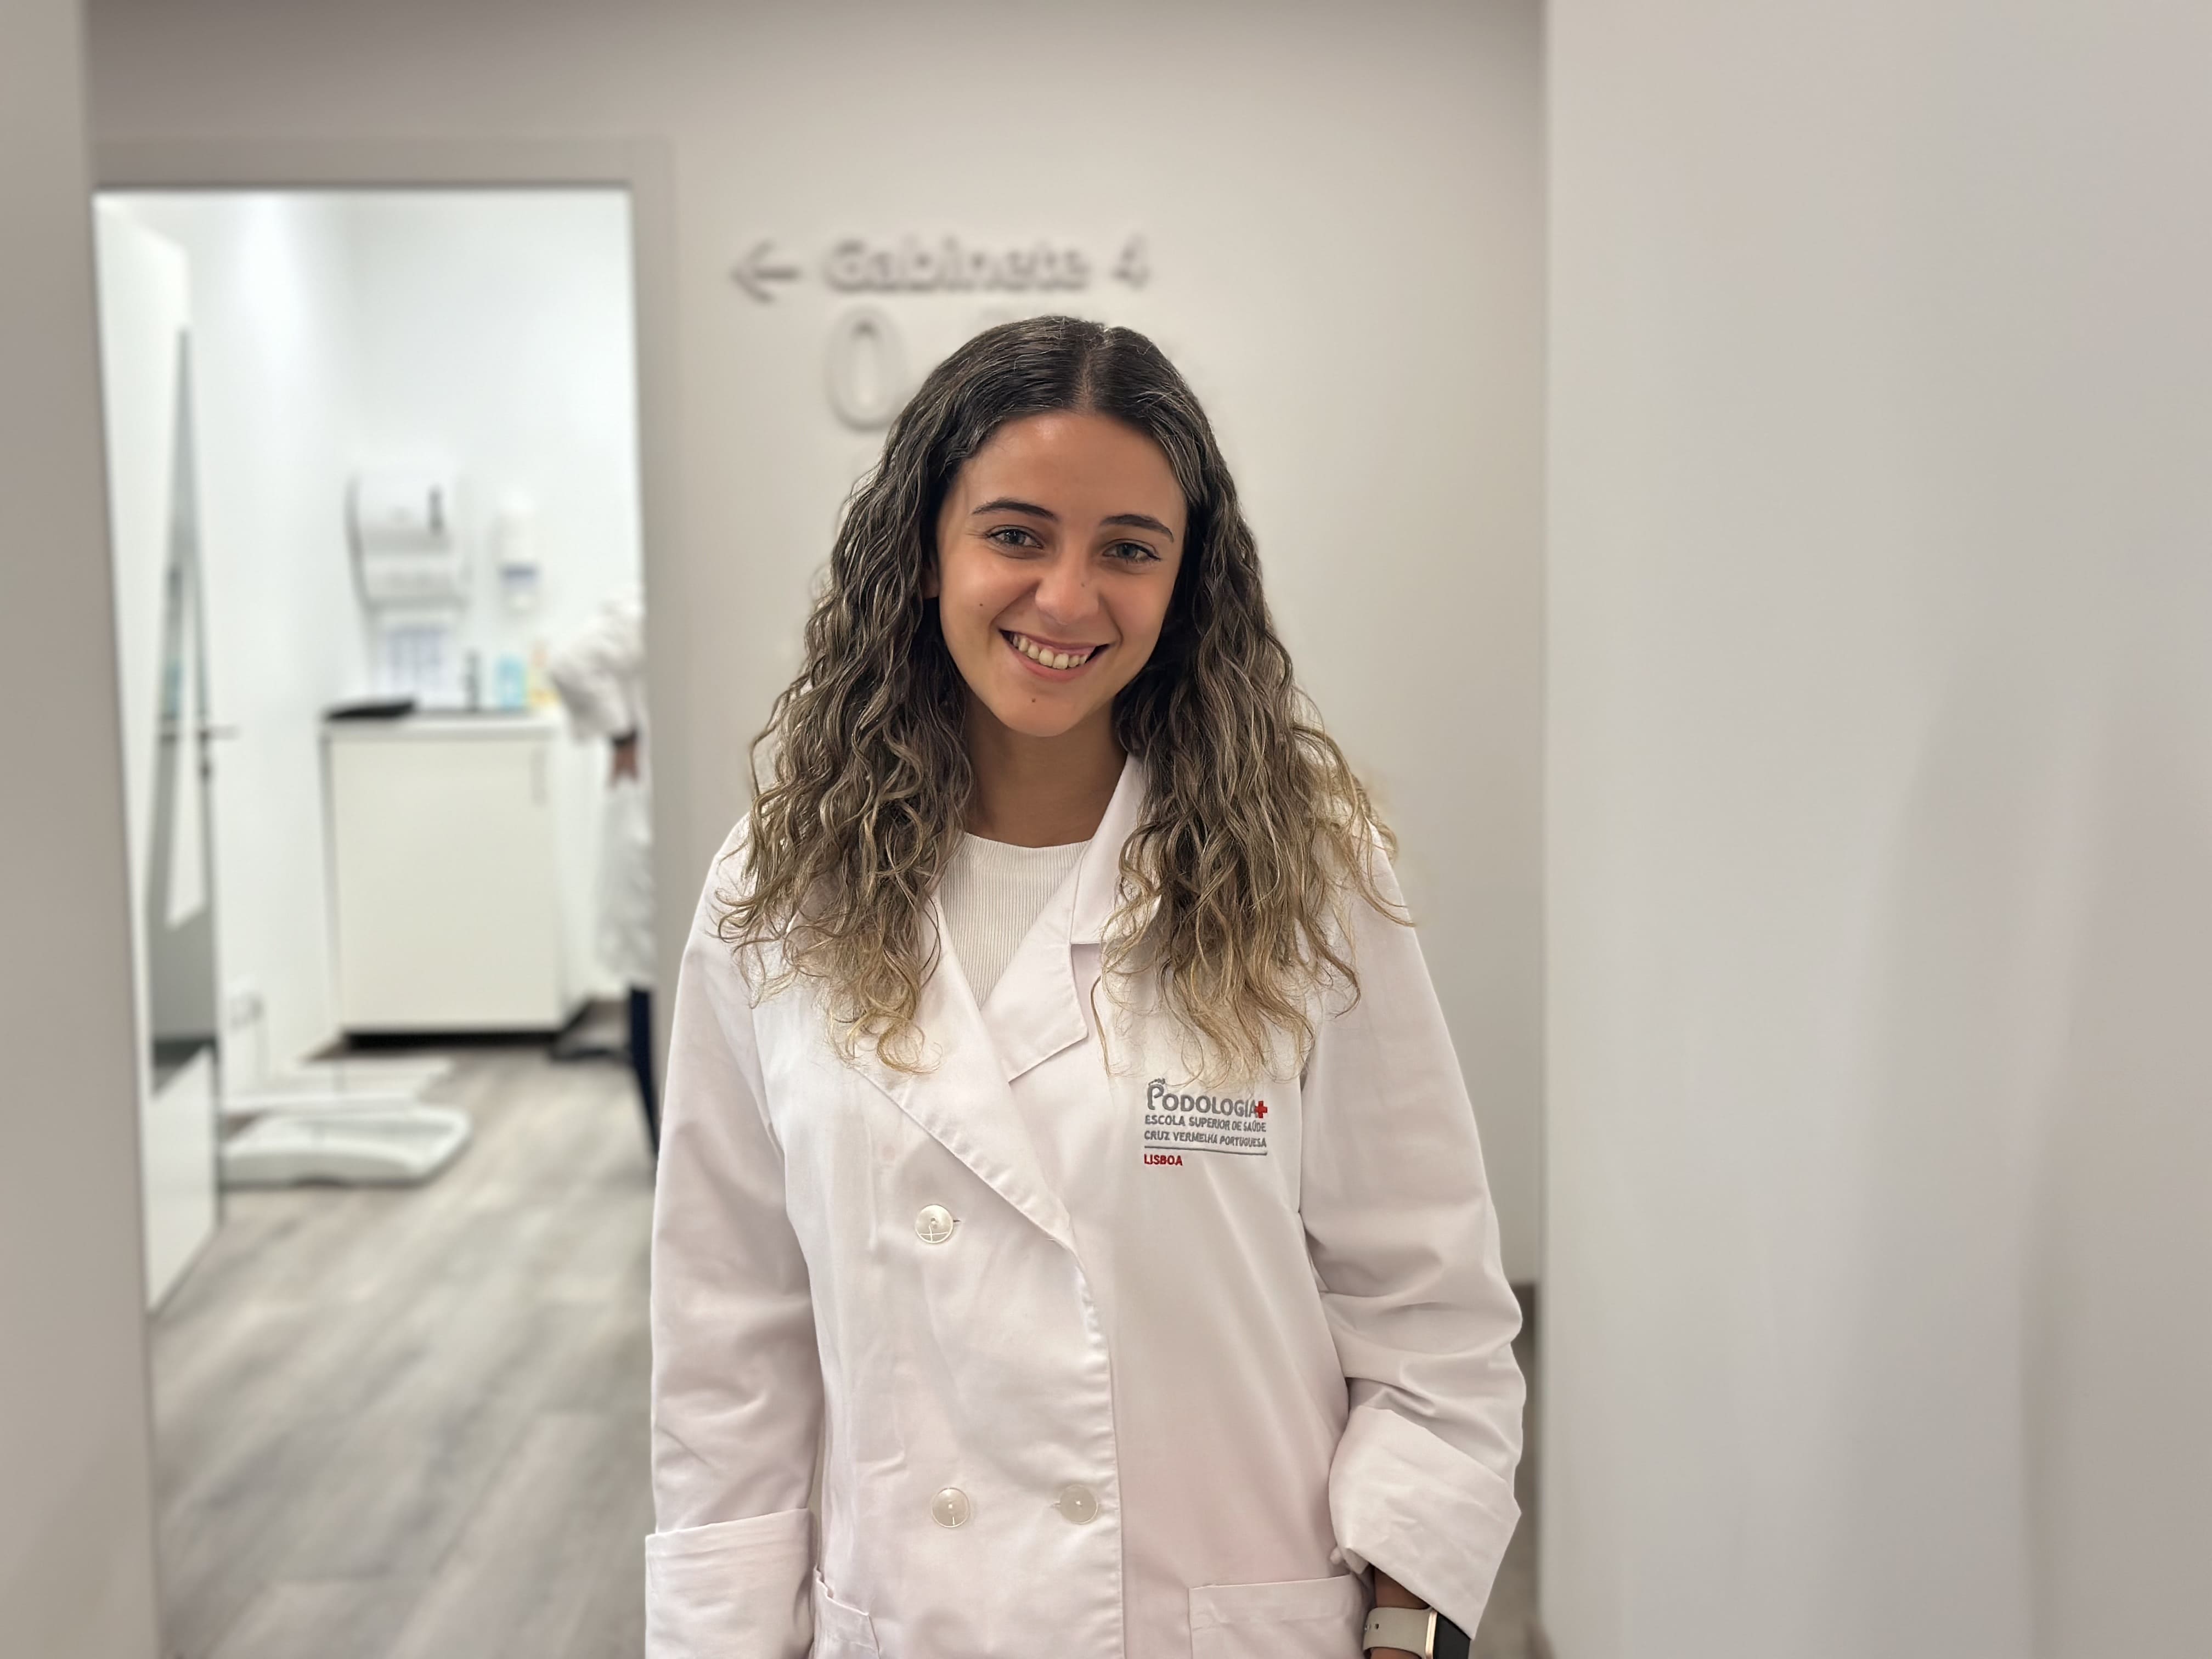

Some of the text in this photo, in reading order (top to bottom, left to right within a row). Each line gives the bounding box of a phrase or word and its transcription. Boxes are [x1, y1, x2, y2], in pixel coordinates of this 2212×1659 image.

[1145, 1114, 1267, 1132] ESCOLA SUPERIOR DE SAÚDE
[1144, 1130, 1267, 1148] CRUZ VERMELHA PORTUGUESA
[1144, 1154, 1183, 1166] LISBOA
